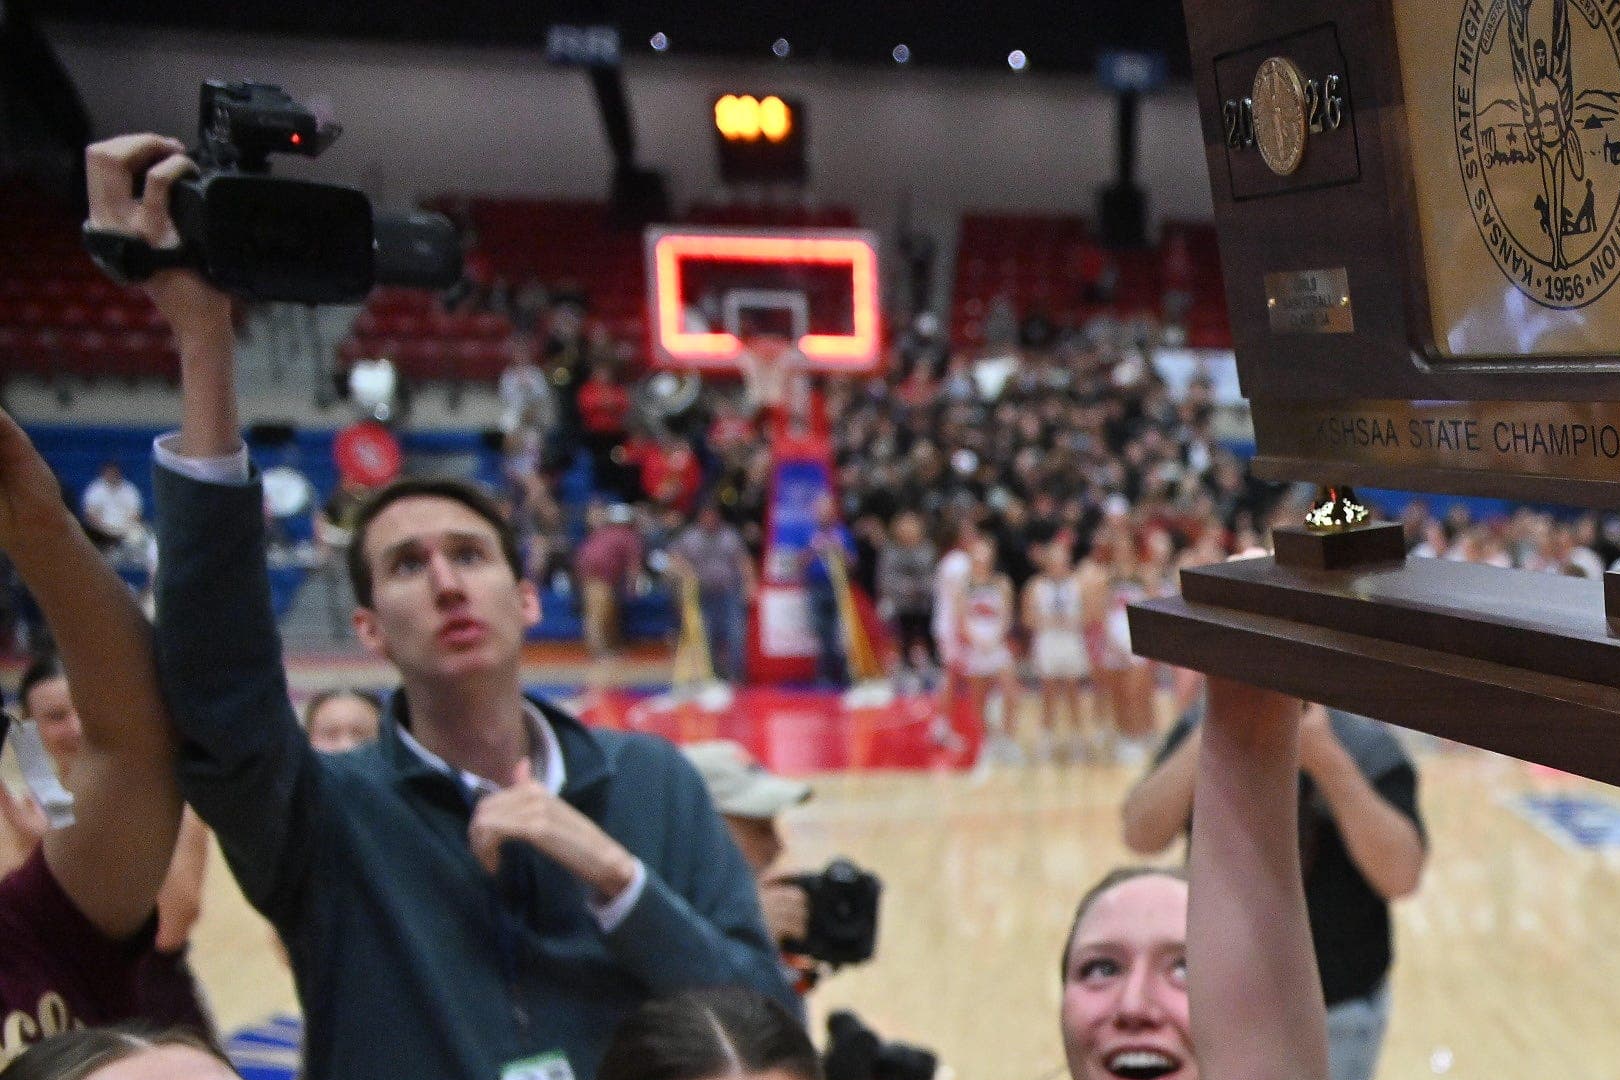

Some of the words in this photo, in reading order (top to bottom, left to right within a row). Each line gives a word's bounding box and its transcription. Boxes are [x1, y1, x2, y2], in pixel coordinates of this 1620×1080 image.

[1458, 0, 1484, 76] HIGH
[1457, 84, 1479, 180] STATE
[1474, 187, 1534, 287] KANSAS
[1544, 274, 1585, 302] 1956
[1409, 419, 1480, 451] STATE
